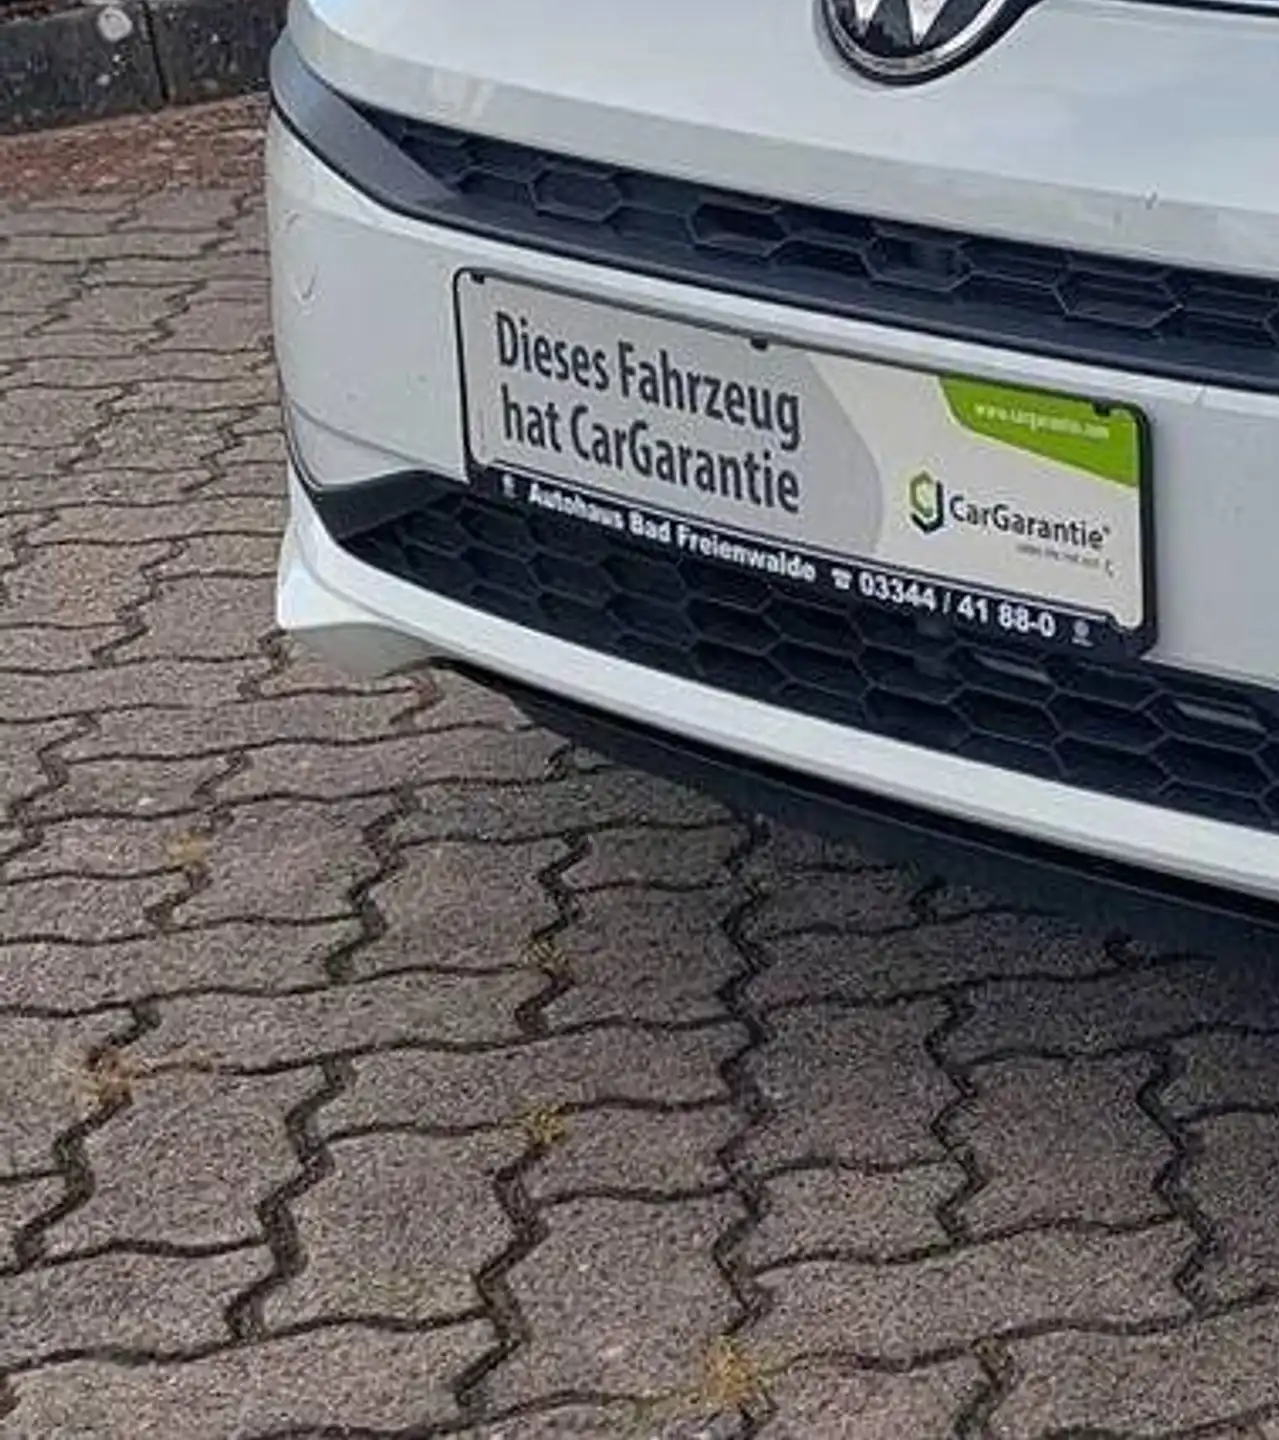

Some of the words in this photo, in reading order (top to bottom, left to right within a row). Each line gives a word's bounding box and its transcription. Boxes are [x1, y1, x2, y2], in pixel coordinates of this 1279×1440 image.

[496, 310, 610, 391] Dieses
[618, 340, 800, 452] Fahrzeug
[501, 382, 562, 453] hat
[570, 404, 800, 514] CarGarantie
[627, 510, 672, 544] Bad
[676, 523, 817, 582] Freienwalde
[859, 572, 936, 612] 03344
[956, 595, 989, 624] 41
[999, 603, 1057, 638] 88-0
